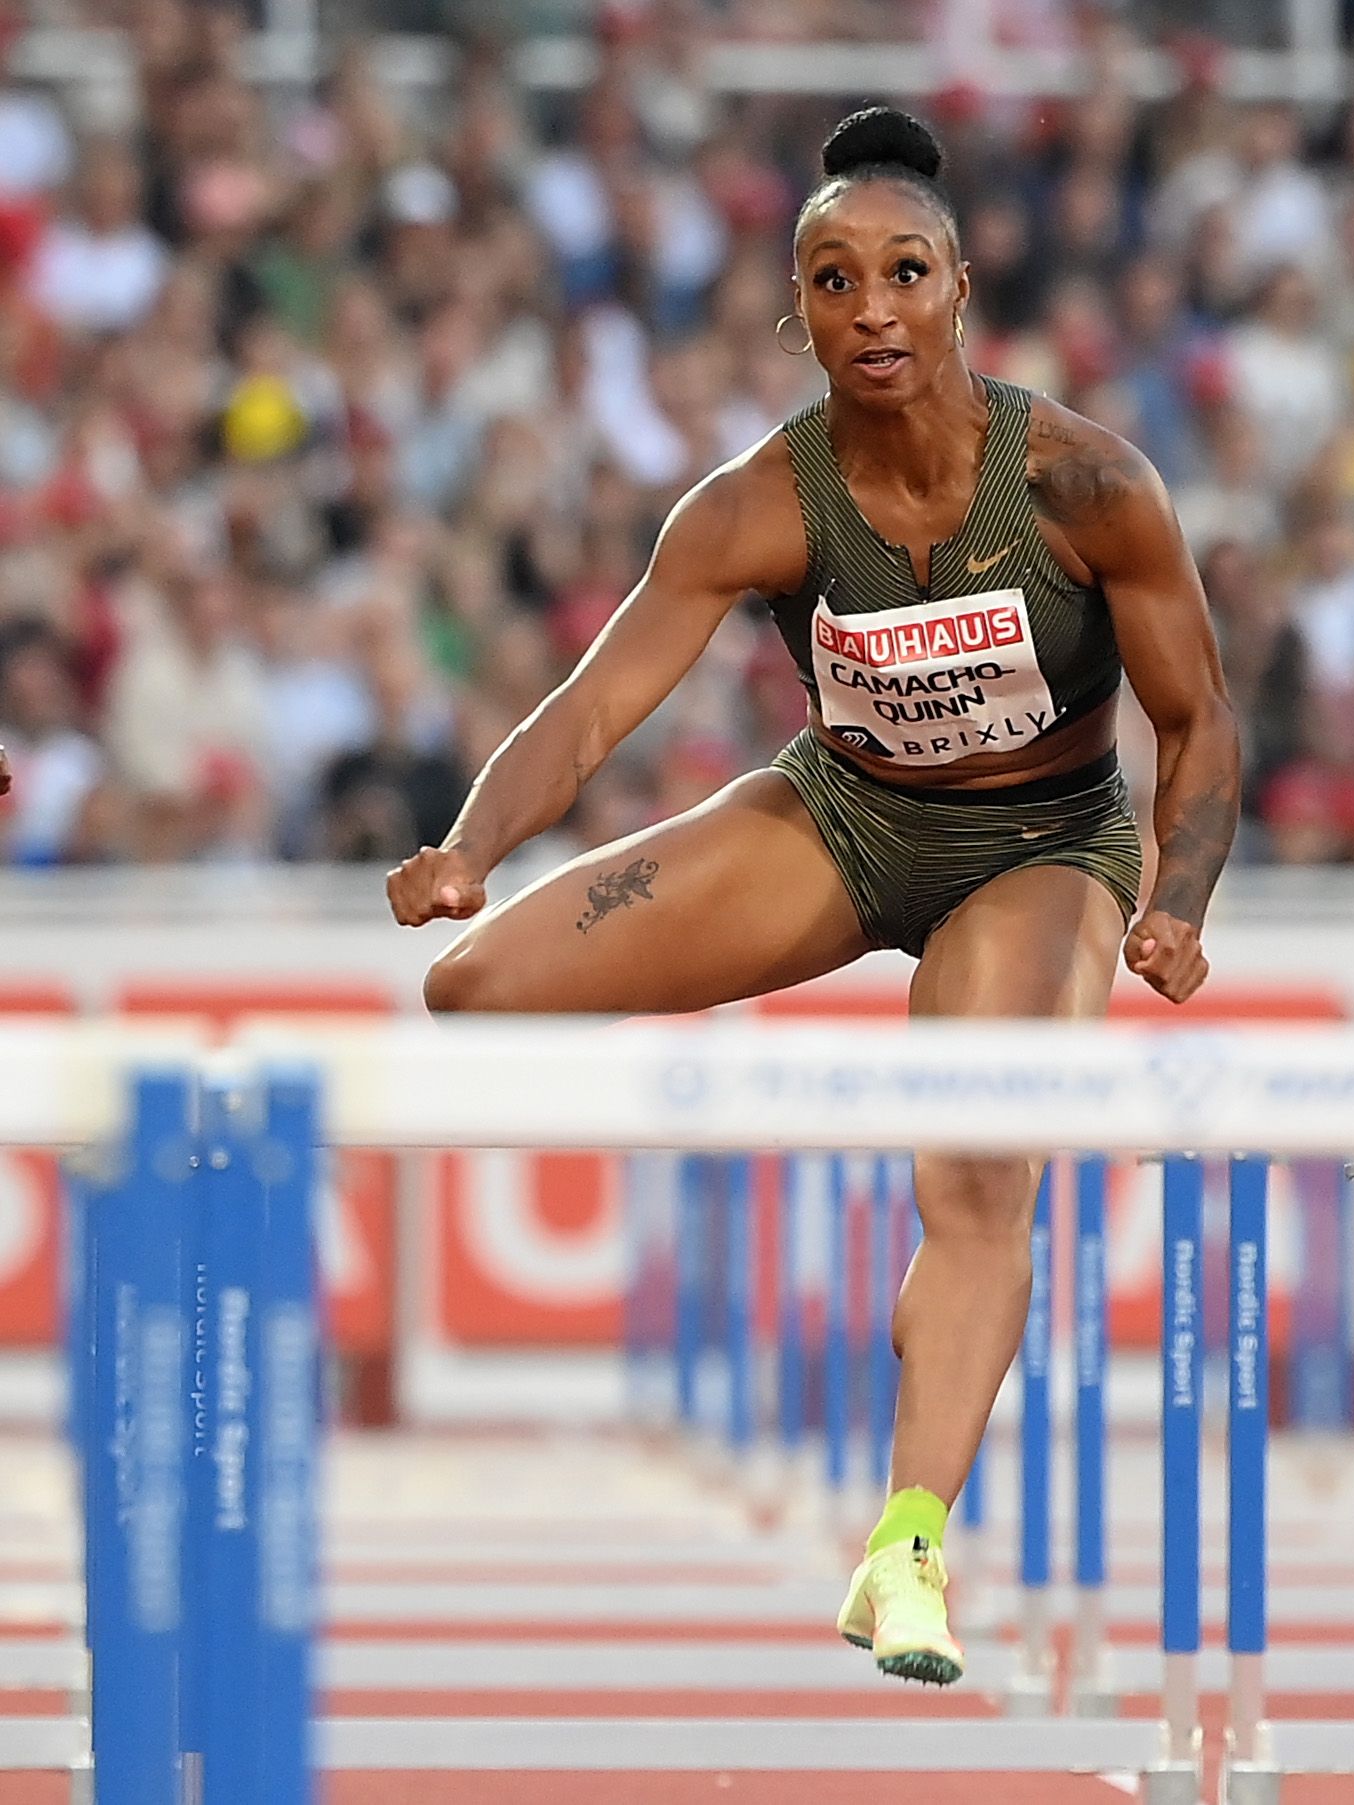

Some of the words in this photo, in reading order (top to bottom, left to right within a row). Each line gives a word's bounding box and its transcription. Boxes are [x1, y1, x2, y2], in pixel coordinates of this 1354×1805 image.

[818, 609, 1020, 665] BAUHAUS
[831, 662, 1015, 696] CAMACHO-
[873, 685, 985, 725] QUINN
